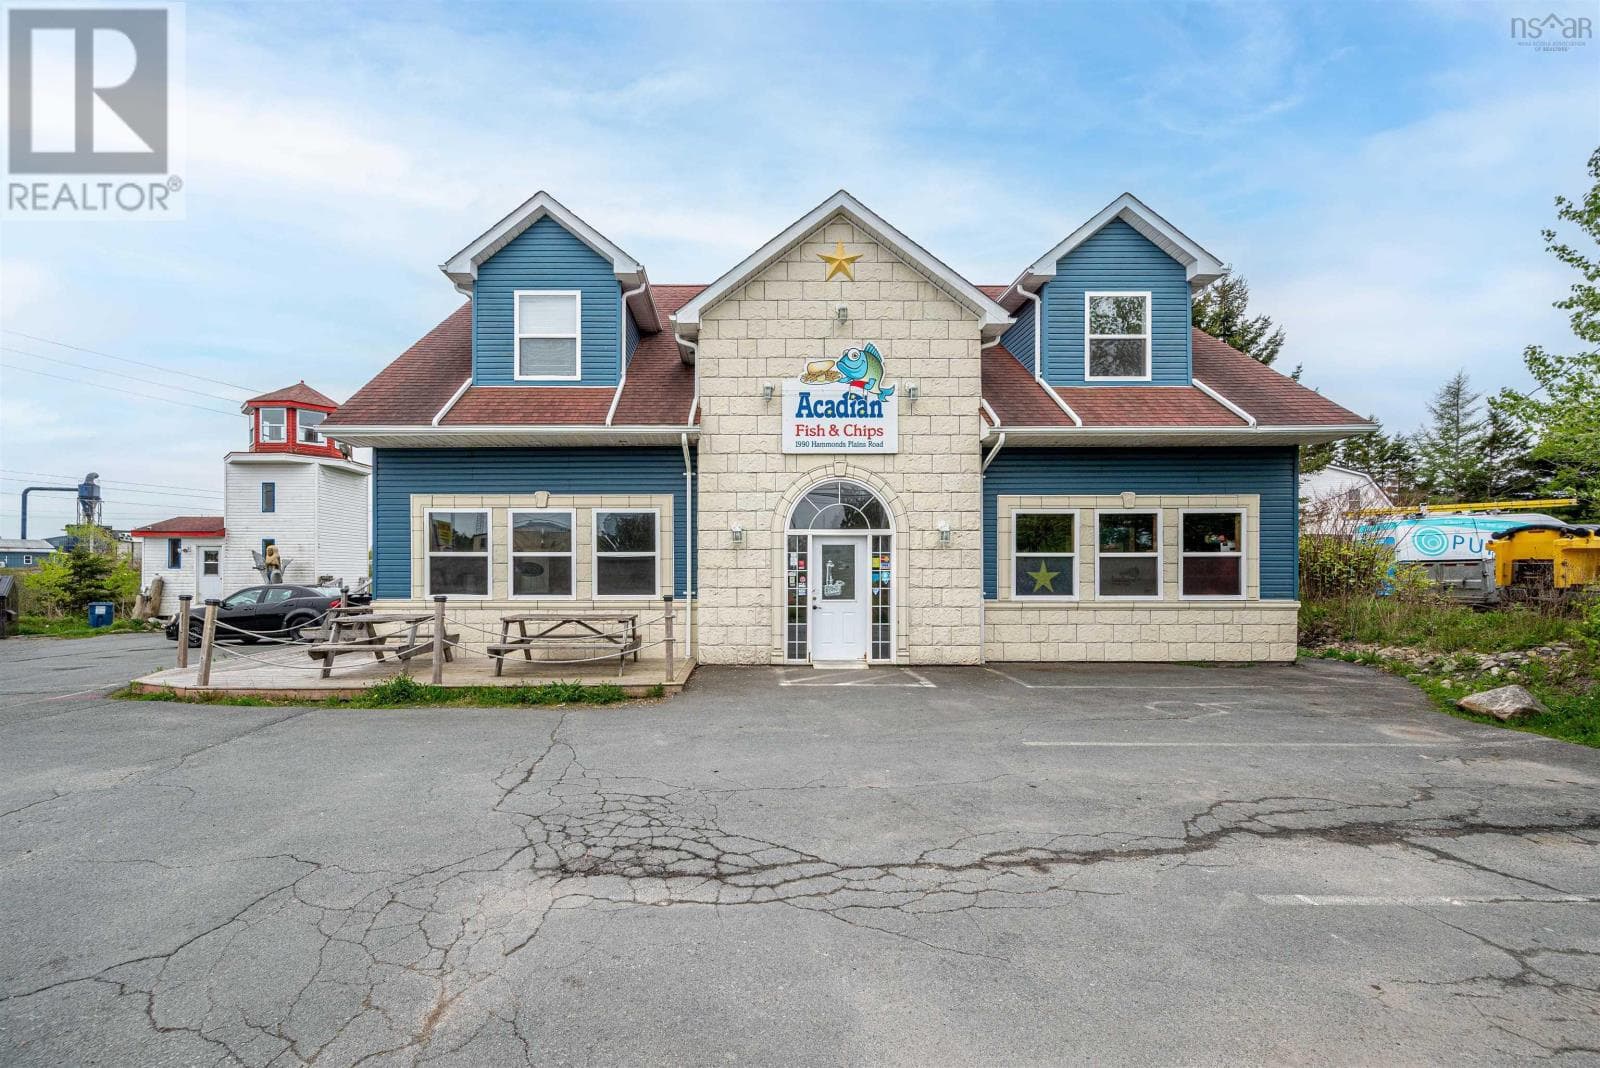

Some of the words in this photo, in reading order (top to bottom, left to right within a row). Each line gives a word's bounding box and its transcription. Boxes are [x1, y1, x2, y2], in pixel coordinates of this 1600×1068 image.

[795, 391, 884, 419] Acadian
[795, 424, 825, 437] Fish
[828, 424, 840, 437] &
[843, 423, 884, 440] Chips
[795, 440, 810, 448] 1990
[811, 440, 846, 448] Hammonds
[847, 440, 866, 448] Plains
[868, 440, 884, 448] Road
[1452, 534, 1491, 556] PU
